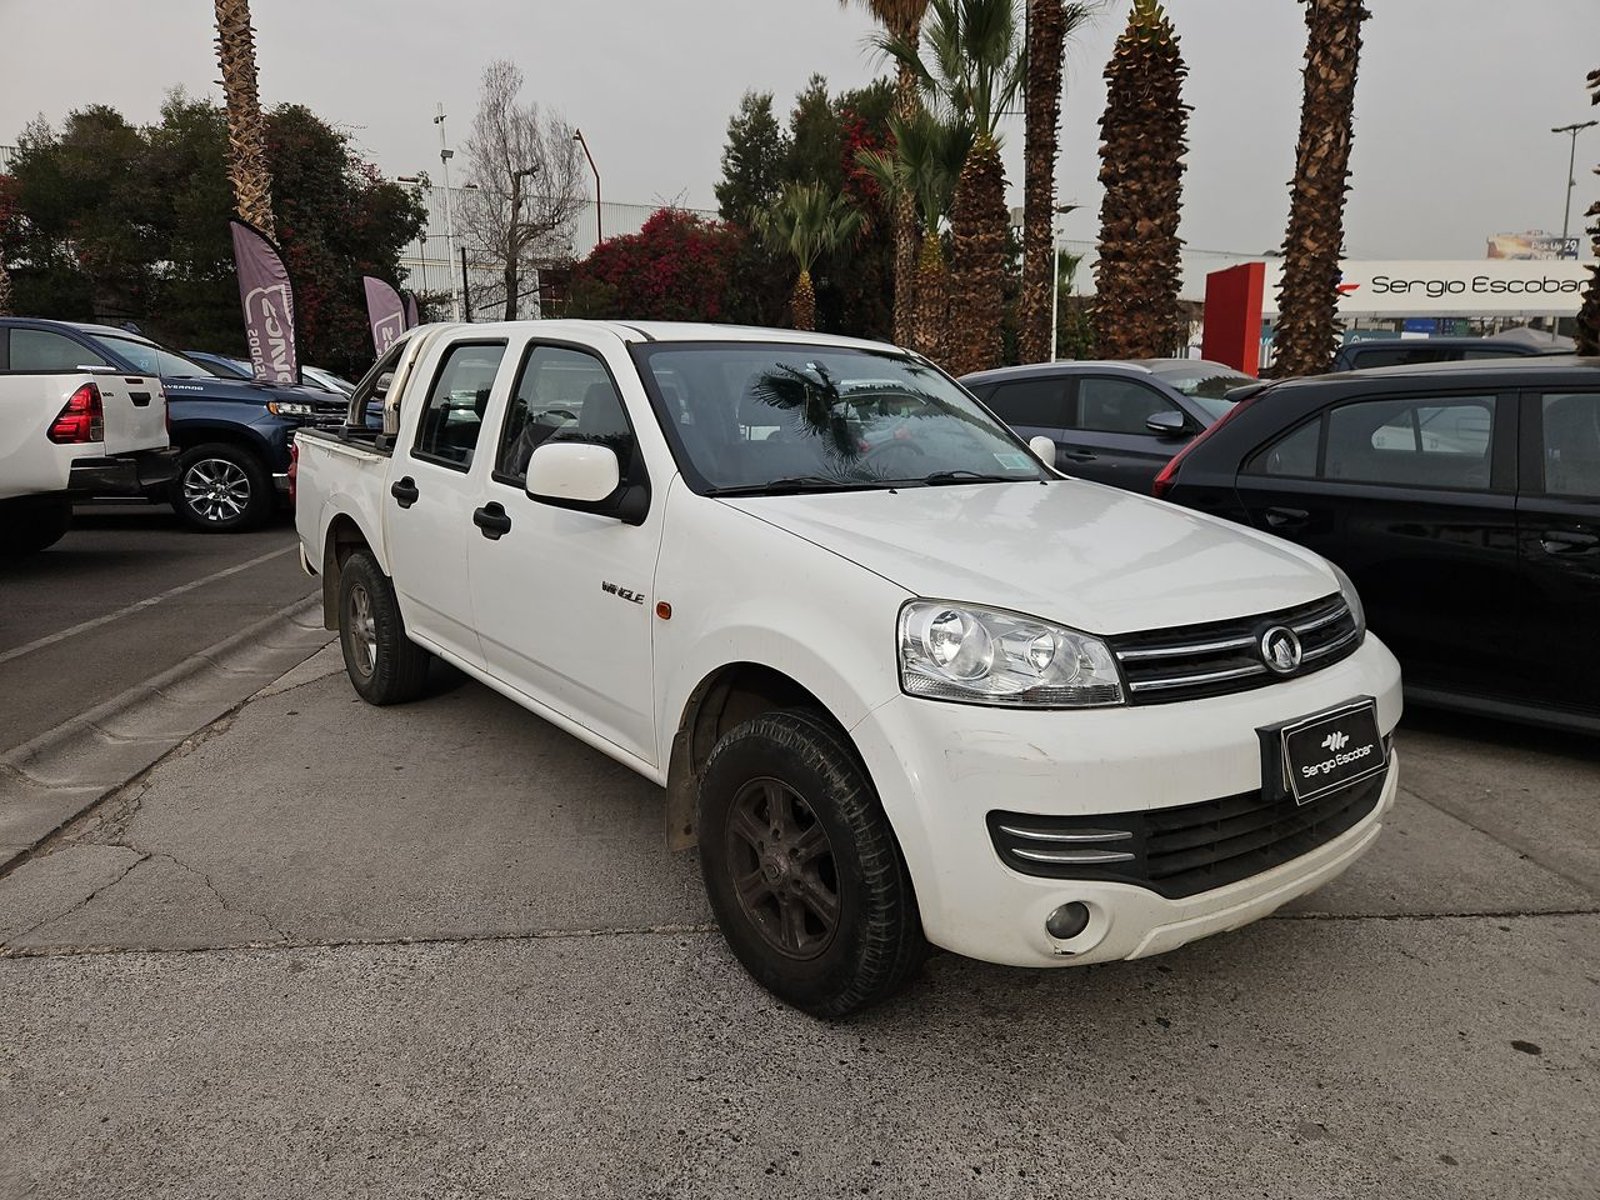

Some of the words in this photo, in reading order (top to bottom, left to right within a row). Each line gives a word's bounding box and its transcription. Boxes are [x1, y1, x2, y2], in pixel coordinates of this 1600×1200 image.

[1371, 275, 1465, 298] Sergio
[1471, 275, 1591, 293] Escobar
[601, 581, 646, 605] WINGLE
[1335, 744, 1373, 765] Escobar
